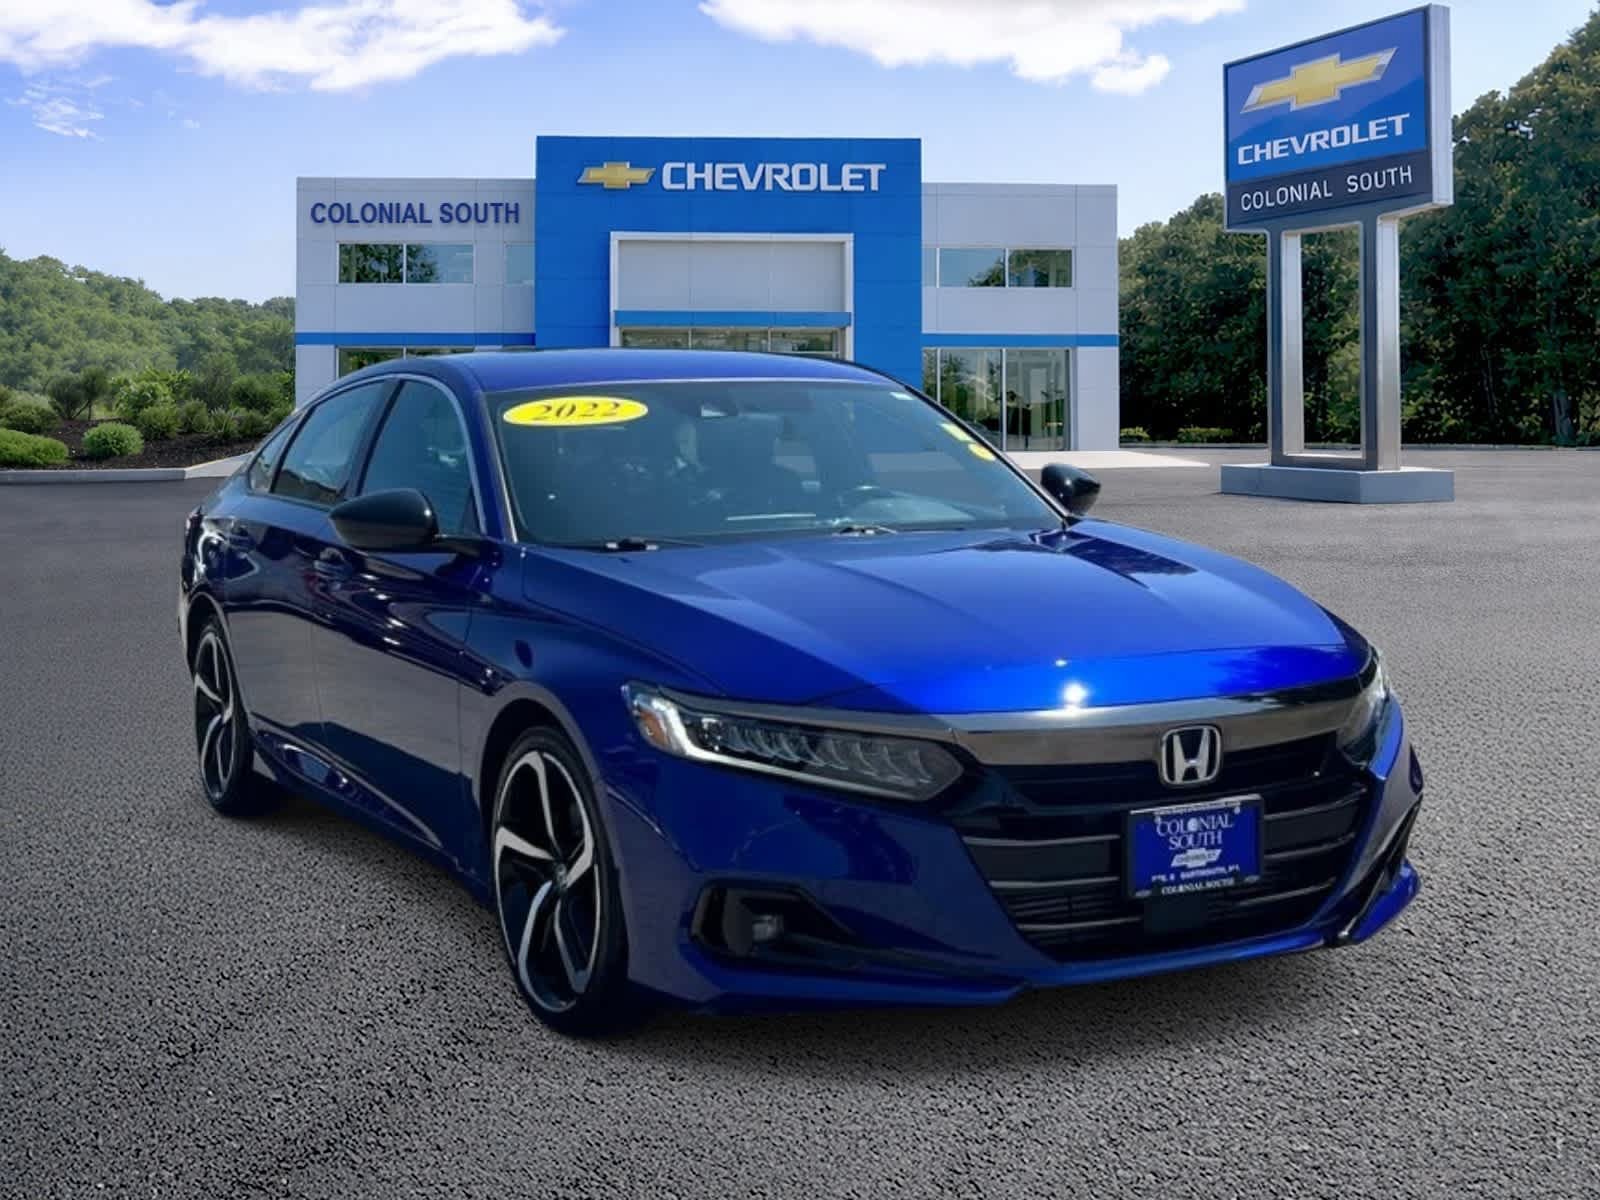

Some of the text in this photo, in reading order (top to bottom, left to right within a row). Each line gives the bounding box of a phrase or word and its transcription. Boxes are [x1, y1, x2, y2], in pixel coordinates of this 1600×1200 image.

[1238, 113, 1410, 165] CHEVROLET
[662, 161, 887, 192] CHEVROLET
[1240, 165, 1412, 211] COLONIAL SOUTH
[310, 202, 520, 224] COLONIAL SOUTH
[532, 402, 620, 421] 2022
[1157, 813, 1233, 838] COLONIAL
[1169, 830, 1223, 850] SOUTH
